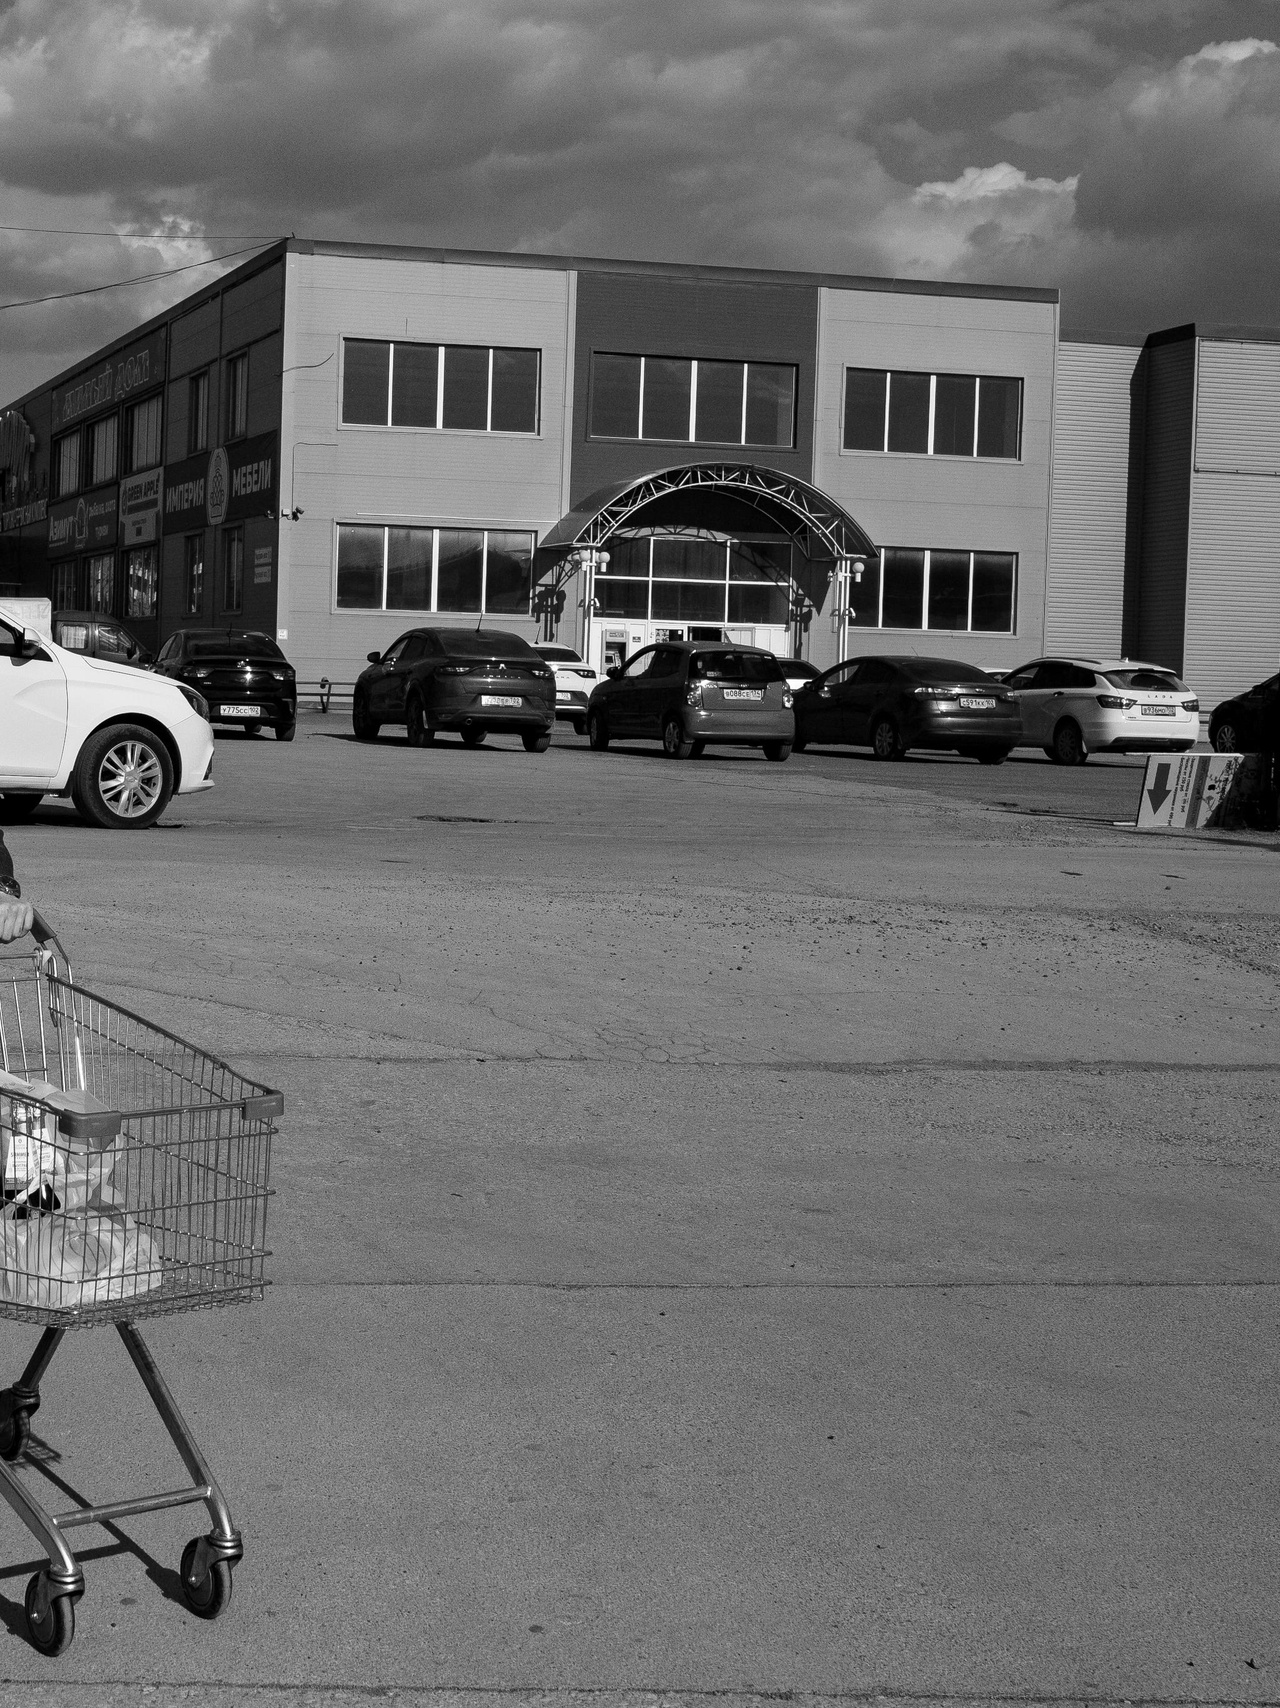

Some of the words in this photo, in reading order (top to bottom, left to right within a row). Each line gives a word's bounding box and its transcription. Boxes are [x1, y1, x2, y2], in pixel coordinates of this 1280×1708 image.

[114, 350, 149, 401] ДОМ
[127, 482, 143, 502] GREEN
[166, 478, 205, 513] ИМПЕРИЯ
[232, 458, 272, 497] МЕБЕЛИ
